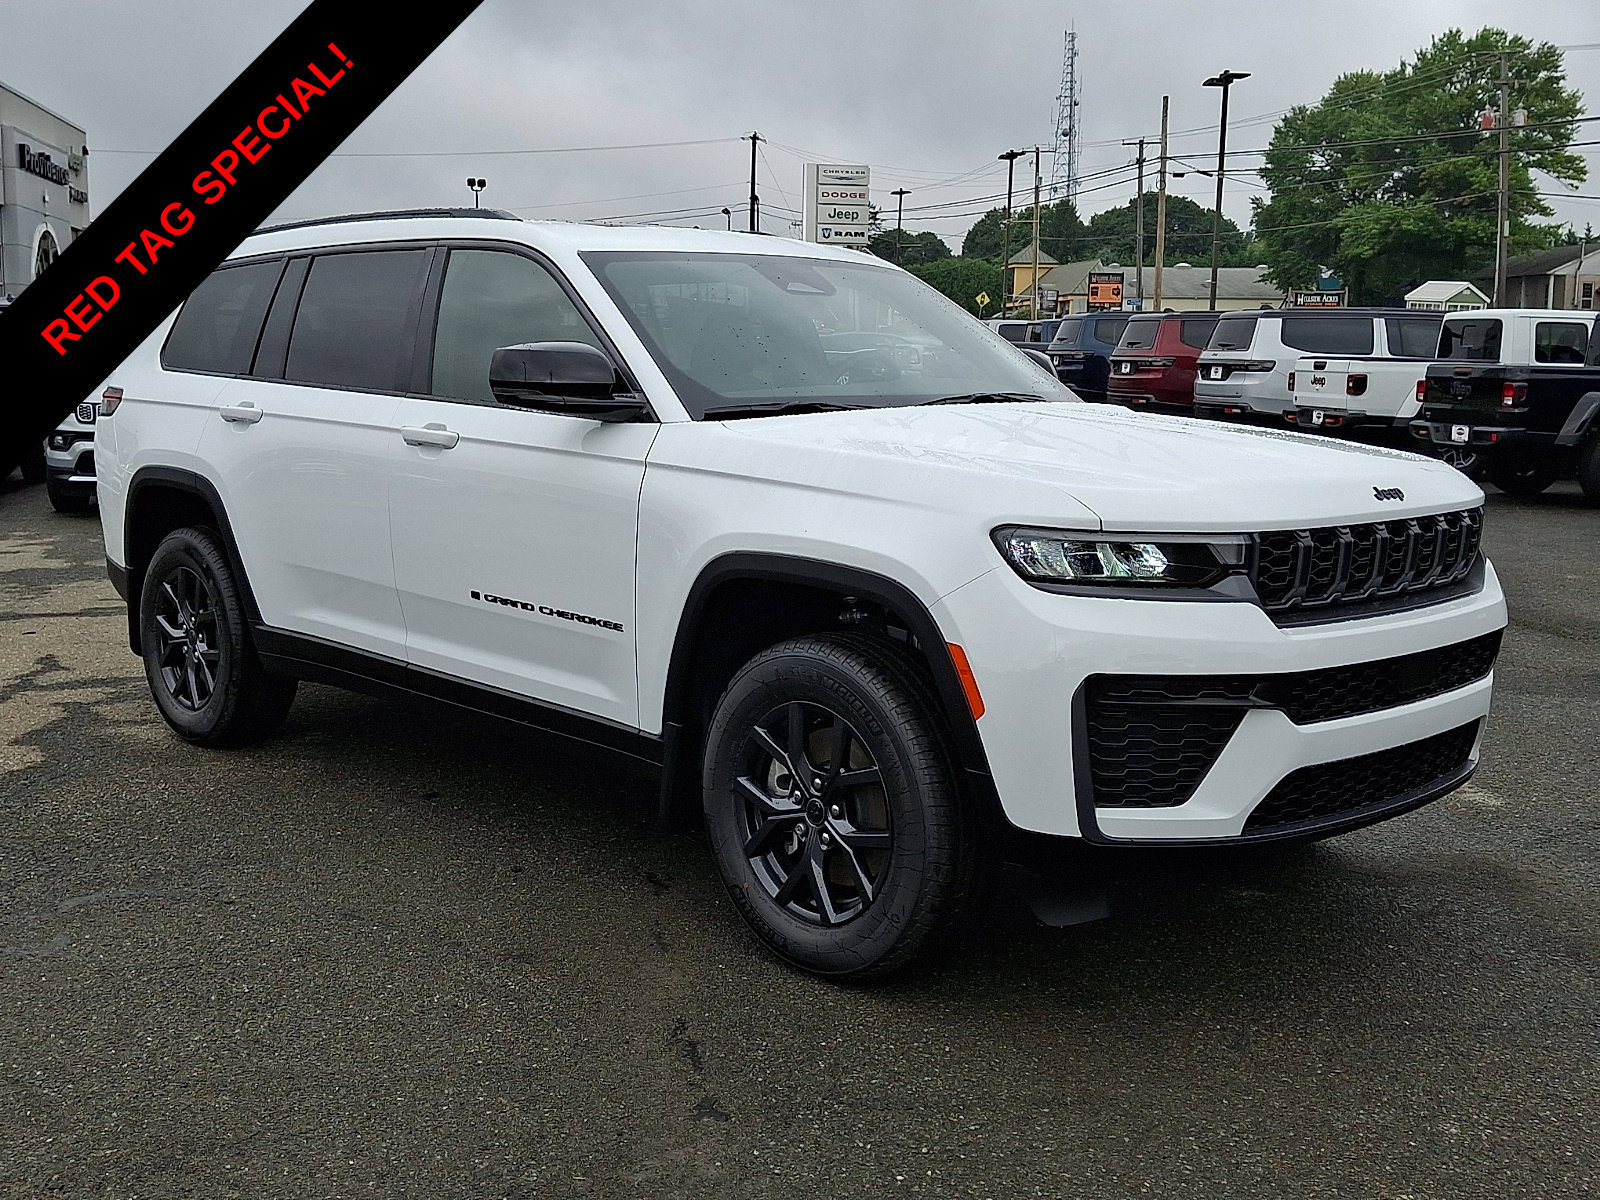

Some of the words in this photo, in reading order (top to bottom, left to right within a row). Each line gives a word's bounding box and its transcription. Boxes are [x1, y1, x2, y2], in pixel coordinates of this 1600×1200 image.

[821, 191, 866, 199] DODGE
[828, 207, 859, 221] Jeep
[1310, 374, 1326, 388] Jeep
[1372, 486, 1405, 502] Jeep
[483, 593, 535, 612] GRAND
[538, 606, 624, 633] CHEROKEE
[822, 676, 882, 736] MICHELIN
